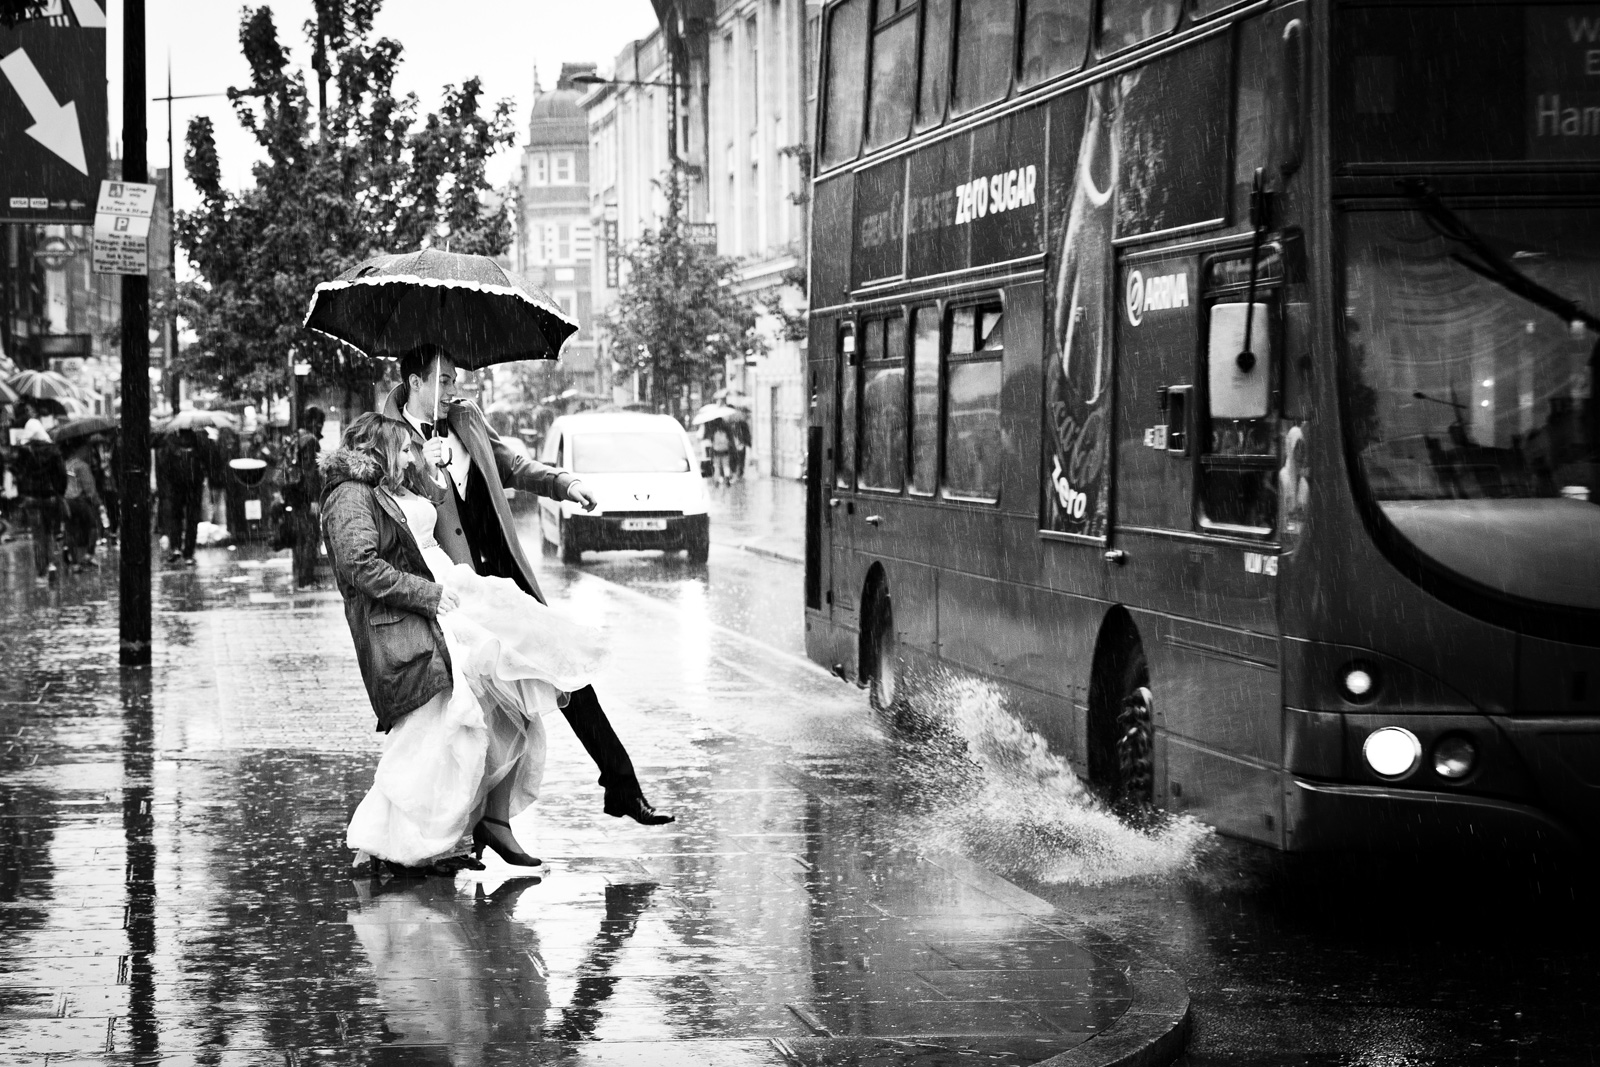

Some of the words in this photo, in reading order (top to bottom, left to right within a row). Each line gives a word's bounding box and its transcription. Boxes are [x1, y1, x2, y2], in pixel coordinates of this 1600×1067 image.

[989, 164, 1037, 214] SUGAR
[116, 218, 128, 231] P
[1143, 273, 1189, 312] ARRIVA
